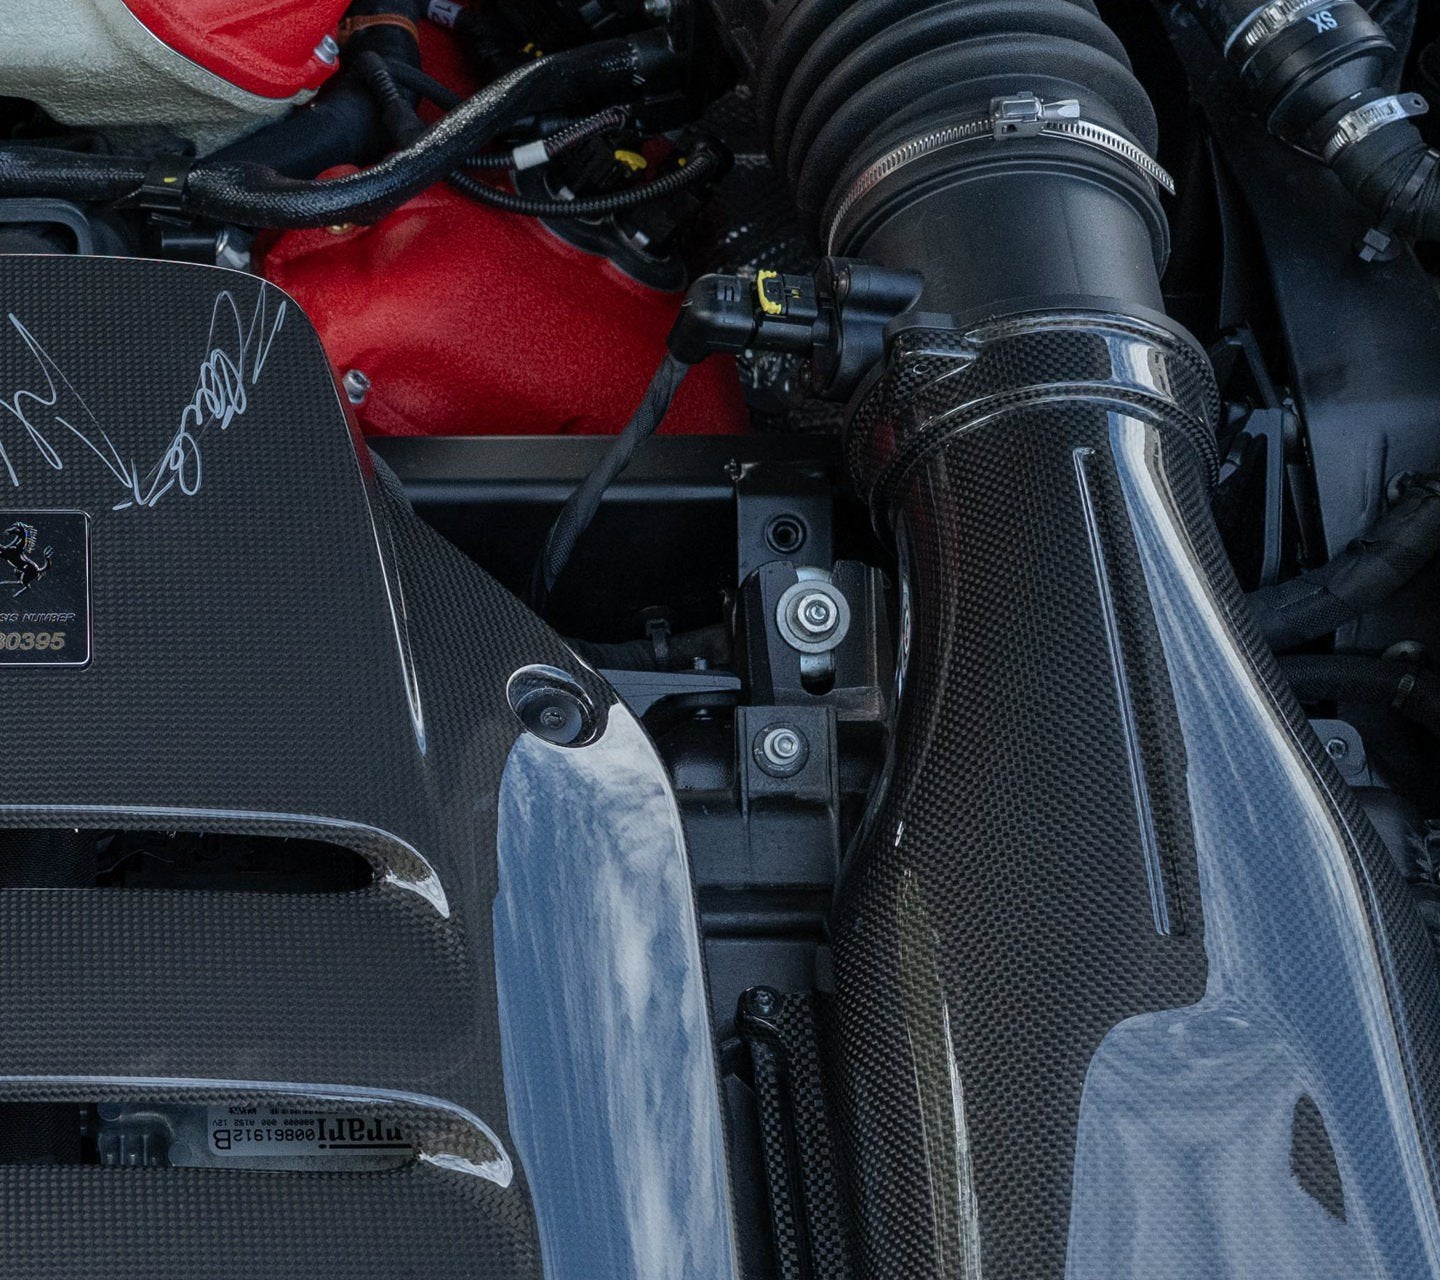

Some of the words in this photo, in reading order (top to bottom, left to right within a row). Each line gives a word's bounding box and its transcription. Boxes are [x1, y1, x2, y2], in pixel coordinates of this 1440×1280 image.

[1307, 10, 1338, 33] SX
[22, 612, 76, 622] NUMBER
[317, 1118, 412, 1150] rrari
